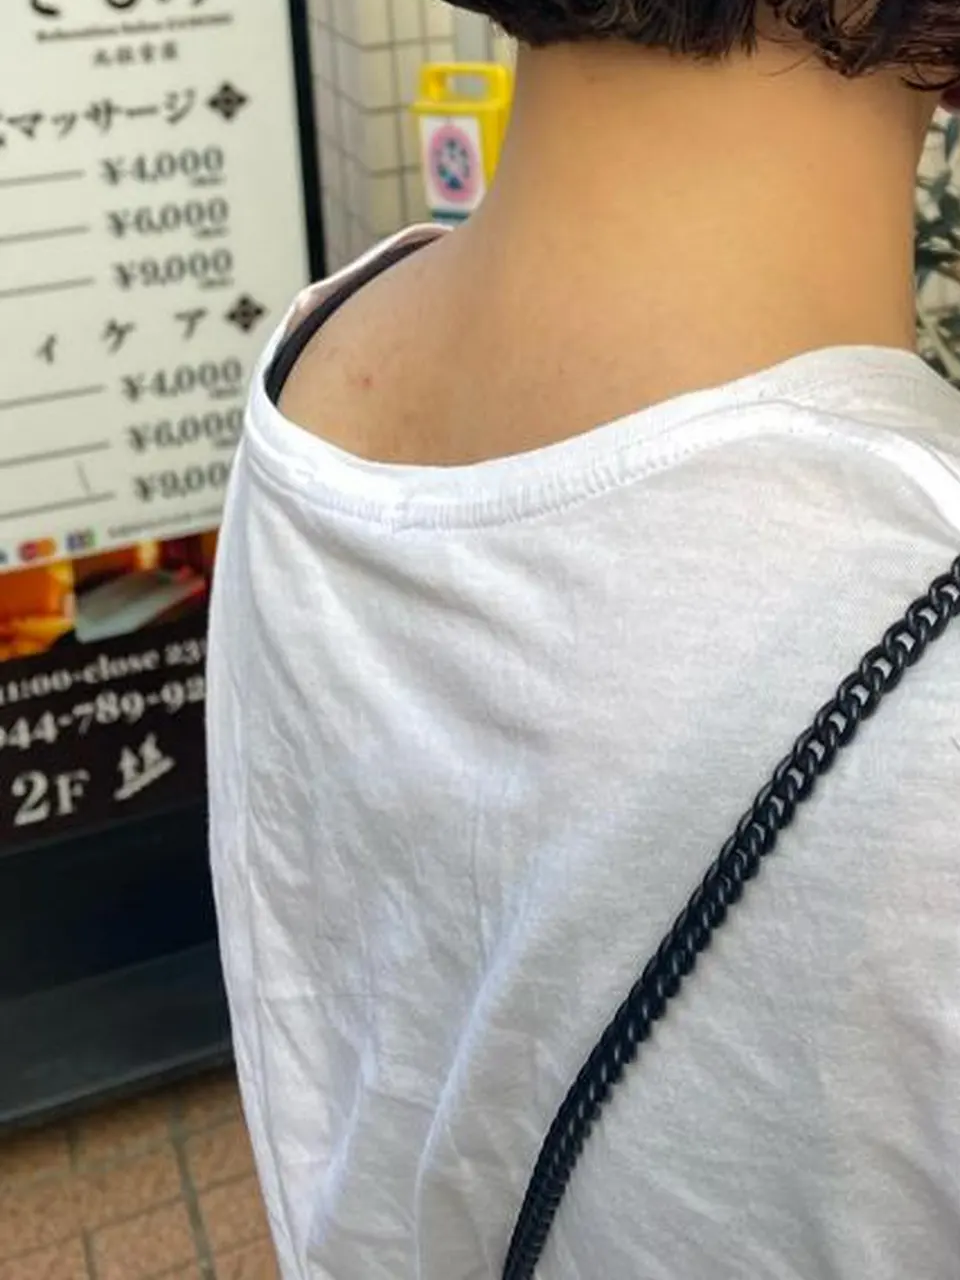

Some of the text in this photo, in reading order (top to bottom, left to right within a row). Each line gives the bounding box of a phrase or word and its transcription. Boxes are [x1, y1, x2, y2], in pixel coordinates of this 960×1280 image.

[0, 87, 197, 146] マッサージ
[100, 144, 225, 187] ¥4,000
[106, 197, 230, 239] ¥6,000
[113, 248, 234, 290] ¥9,000
[121, 356, 243, 403] ¥4,000
[133, 460, 234, 505] ¥9,00
[11, 769, 90, 826] 2F
